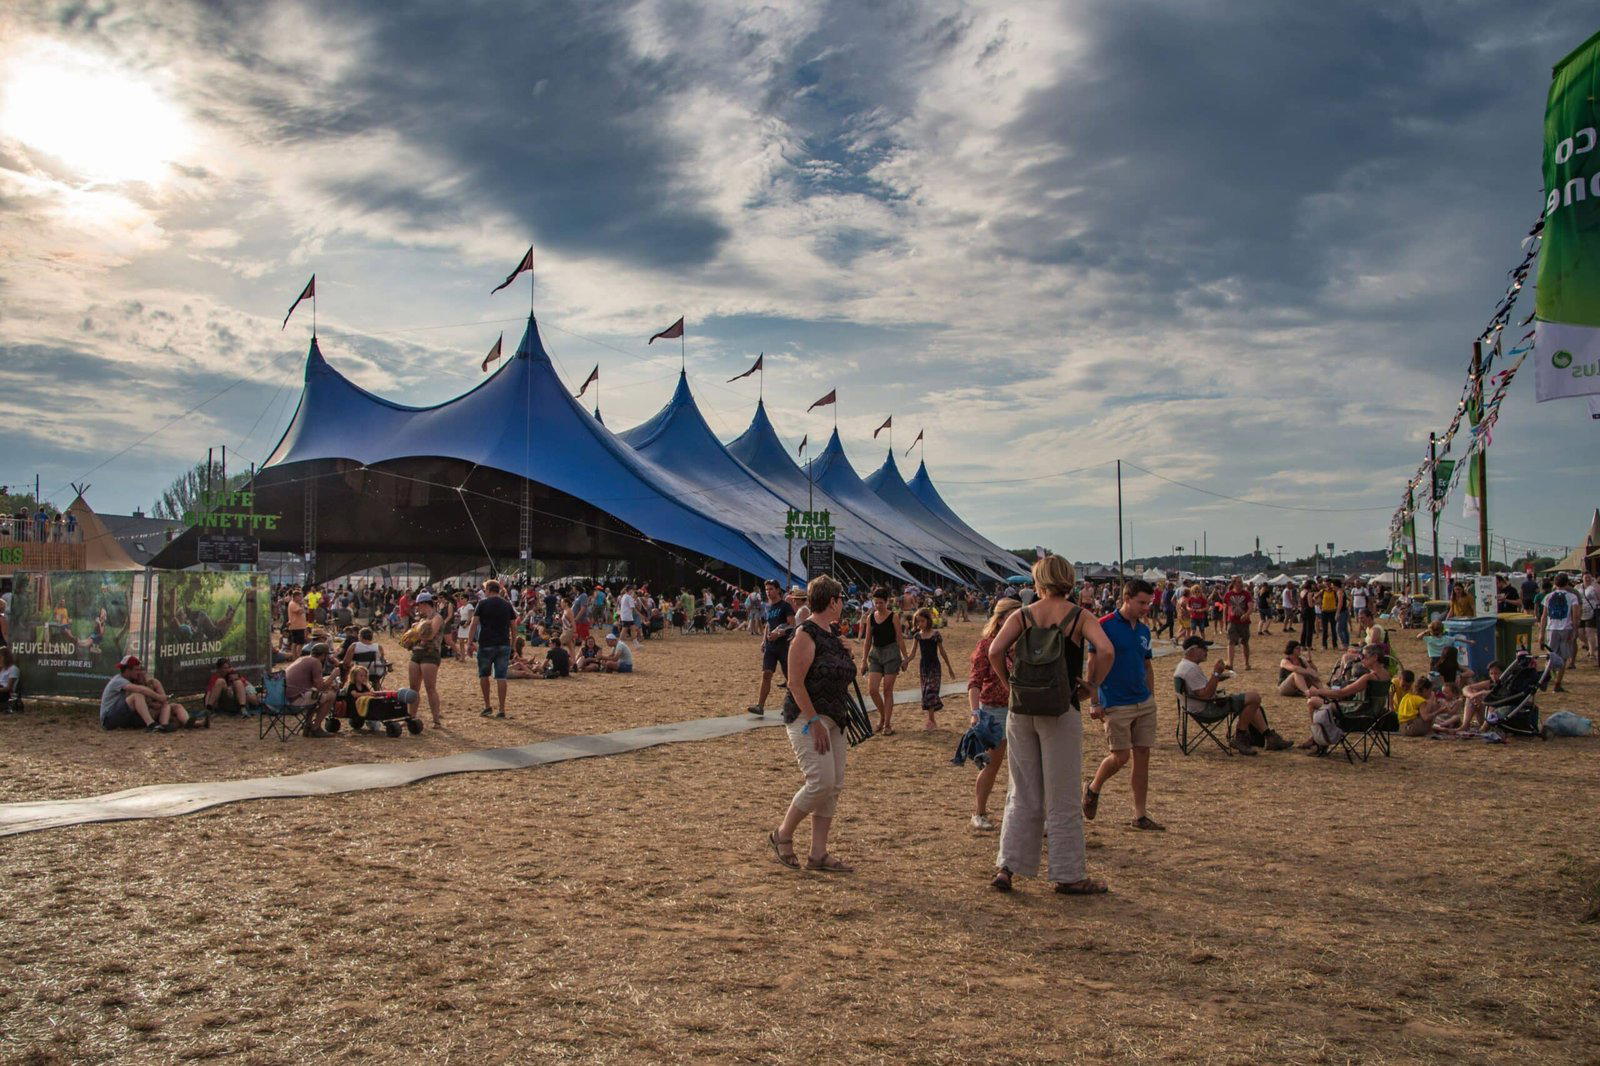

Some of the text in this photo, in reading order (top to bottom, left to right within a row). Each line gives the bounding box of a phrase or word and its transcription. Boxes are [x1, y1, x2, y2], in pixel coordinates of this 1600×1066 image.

[183, 512, 277, 530] GINETTE
[786, 511, 830, 525] MAIN
[784, 526, 836, 540] STAGE
[11, 641, 76, 655] HEUVELLAND
[160, 640, 222, 657] HEUVELLAND
